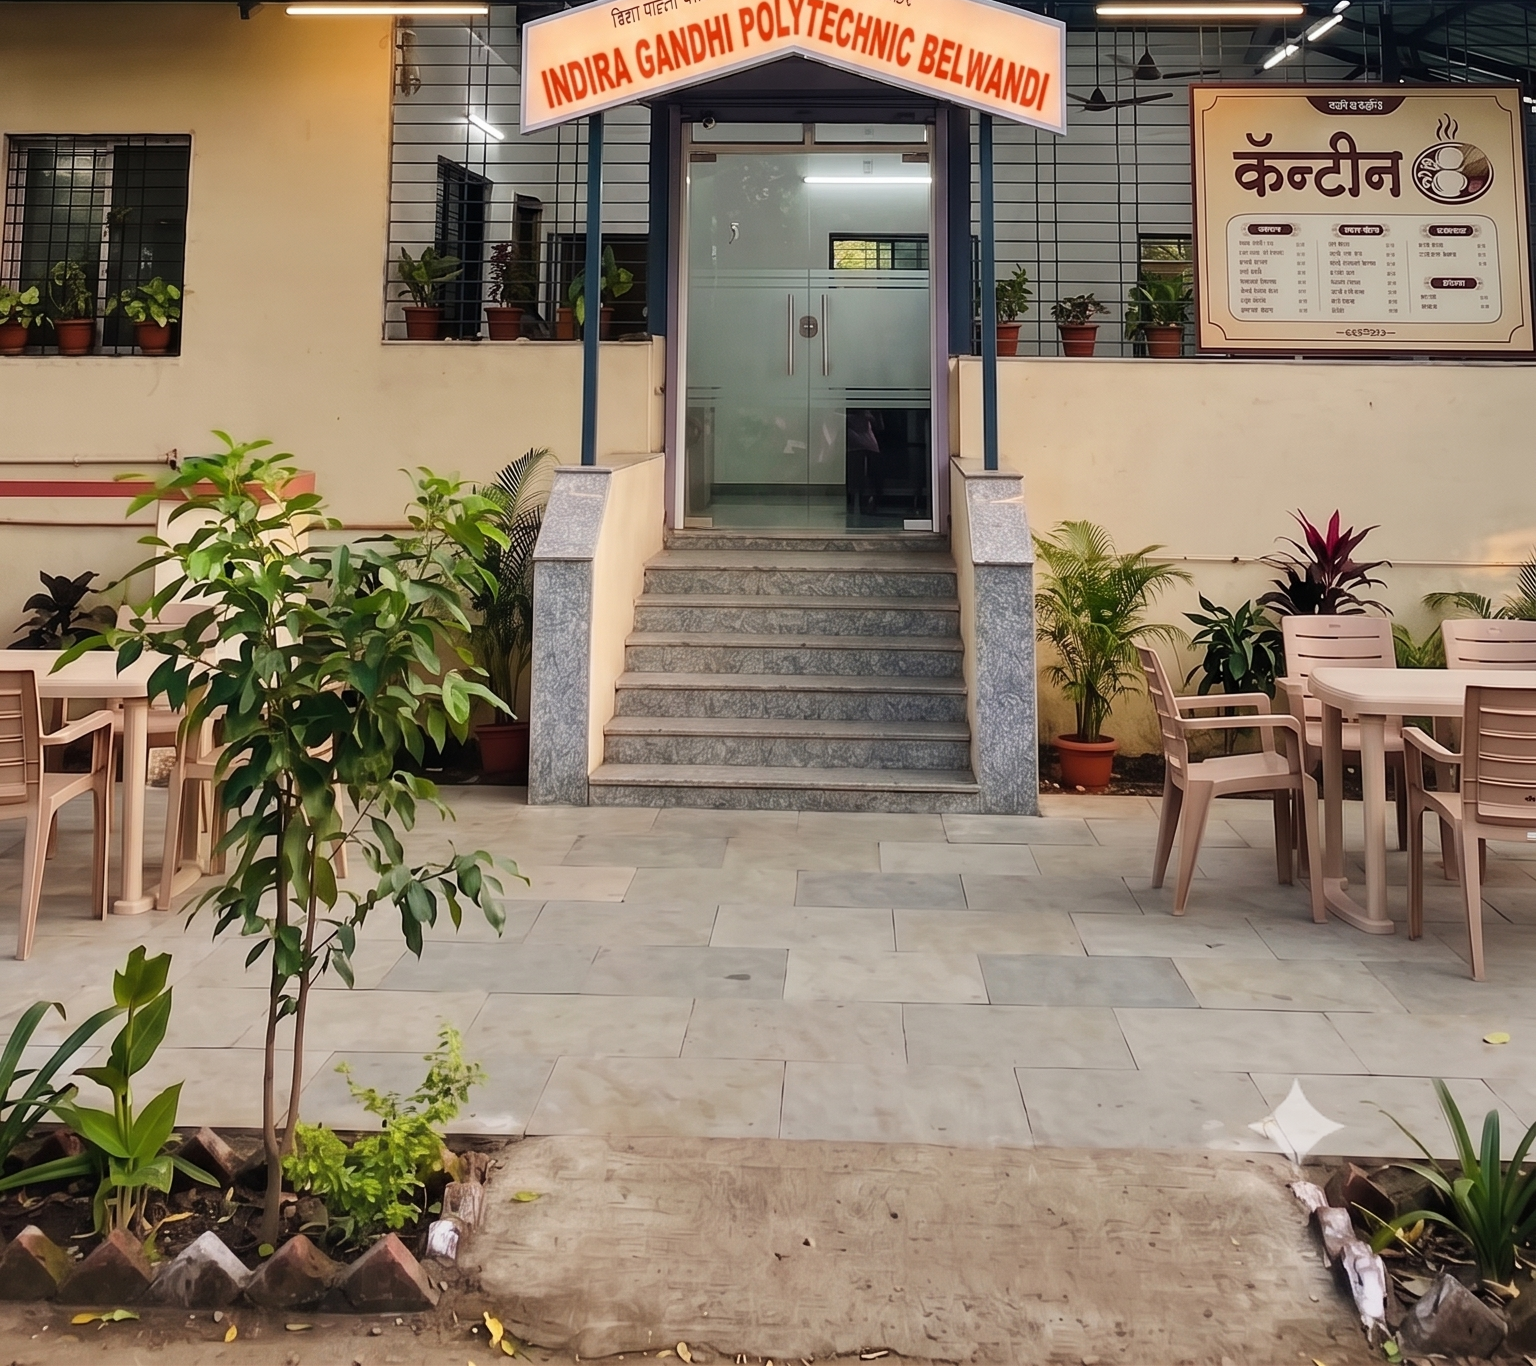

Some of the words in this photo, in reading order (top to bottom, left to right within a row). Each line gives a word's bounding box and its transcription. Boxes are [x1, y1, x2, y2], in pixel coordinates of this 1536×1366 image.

[541, 47, 633, 109] INDIRA
[635, 13, 735, 79] GANDHI
[917, 33, 1051, 112] BELWANDI
